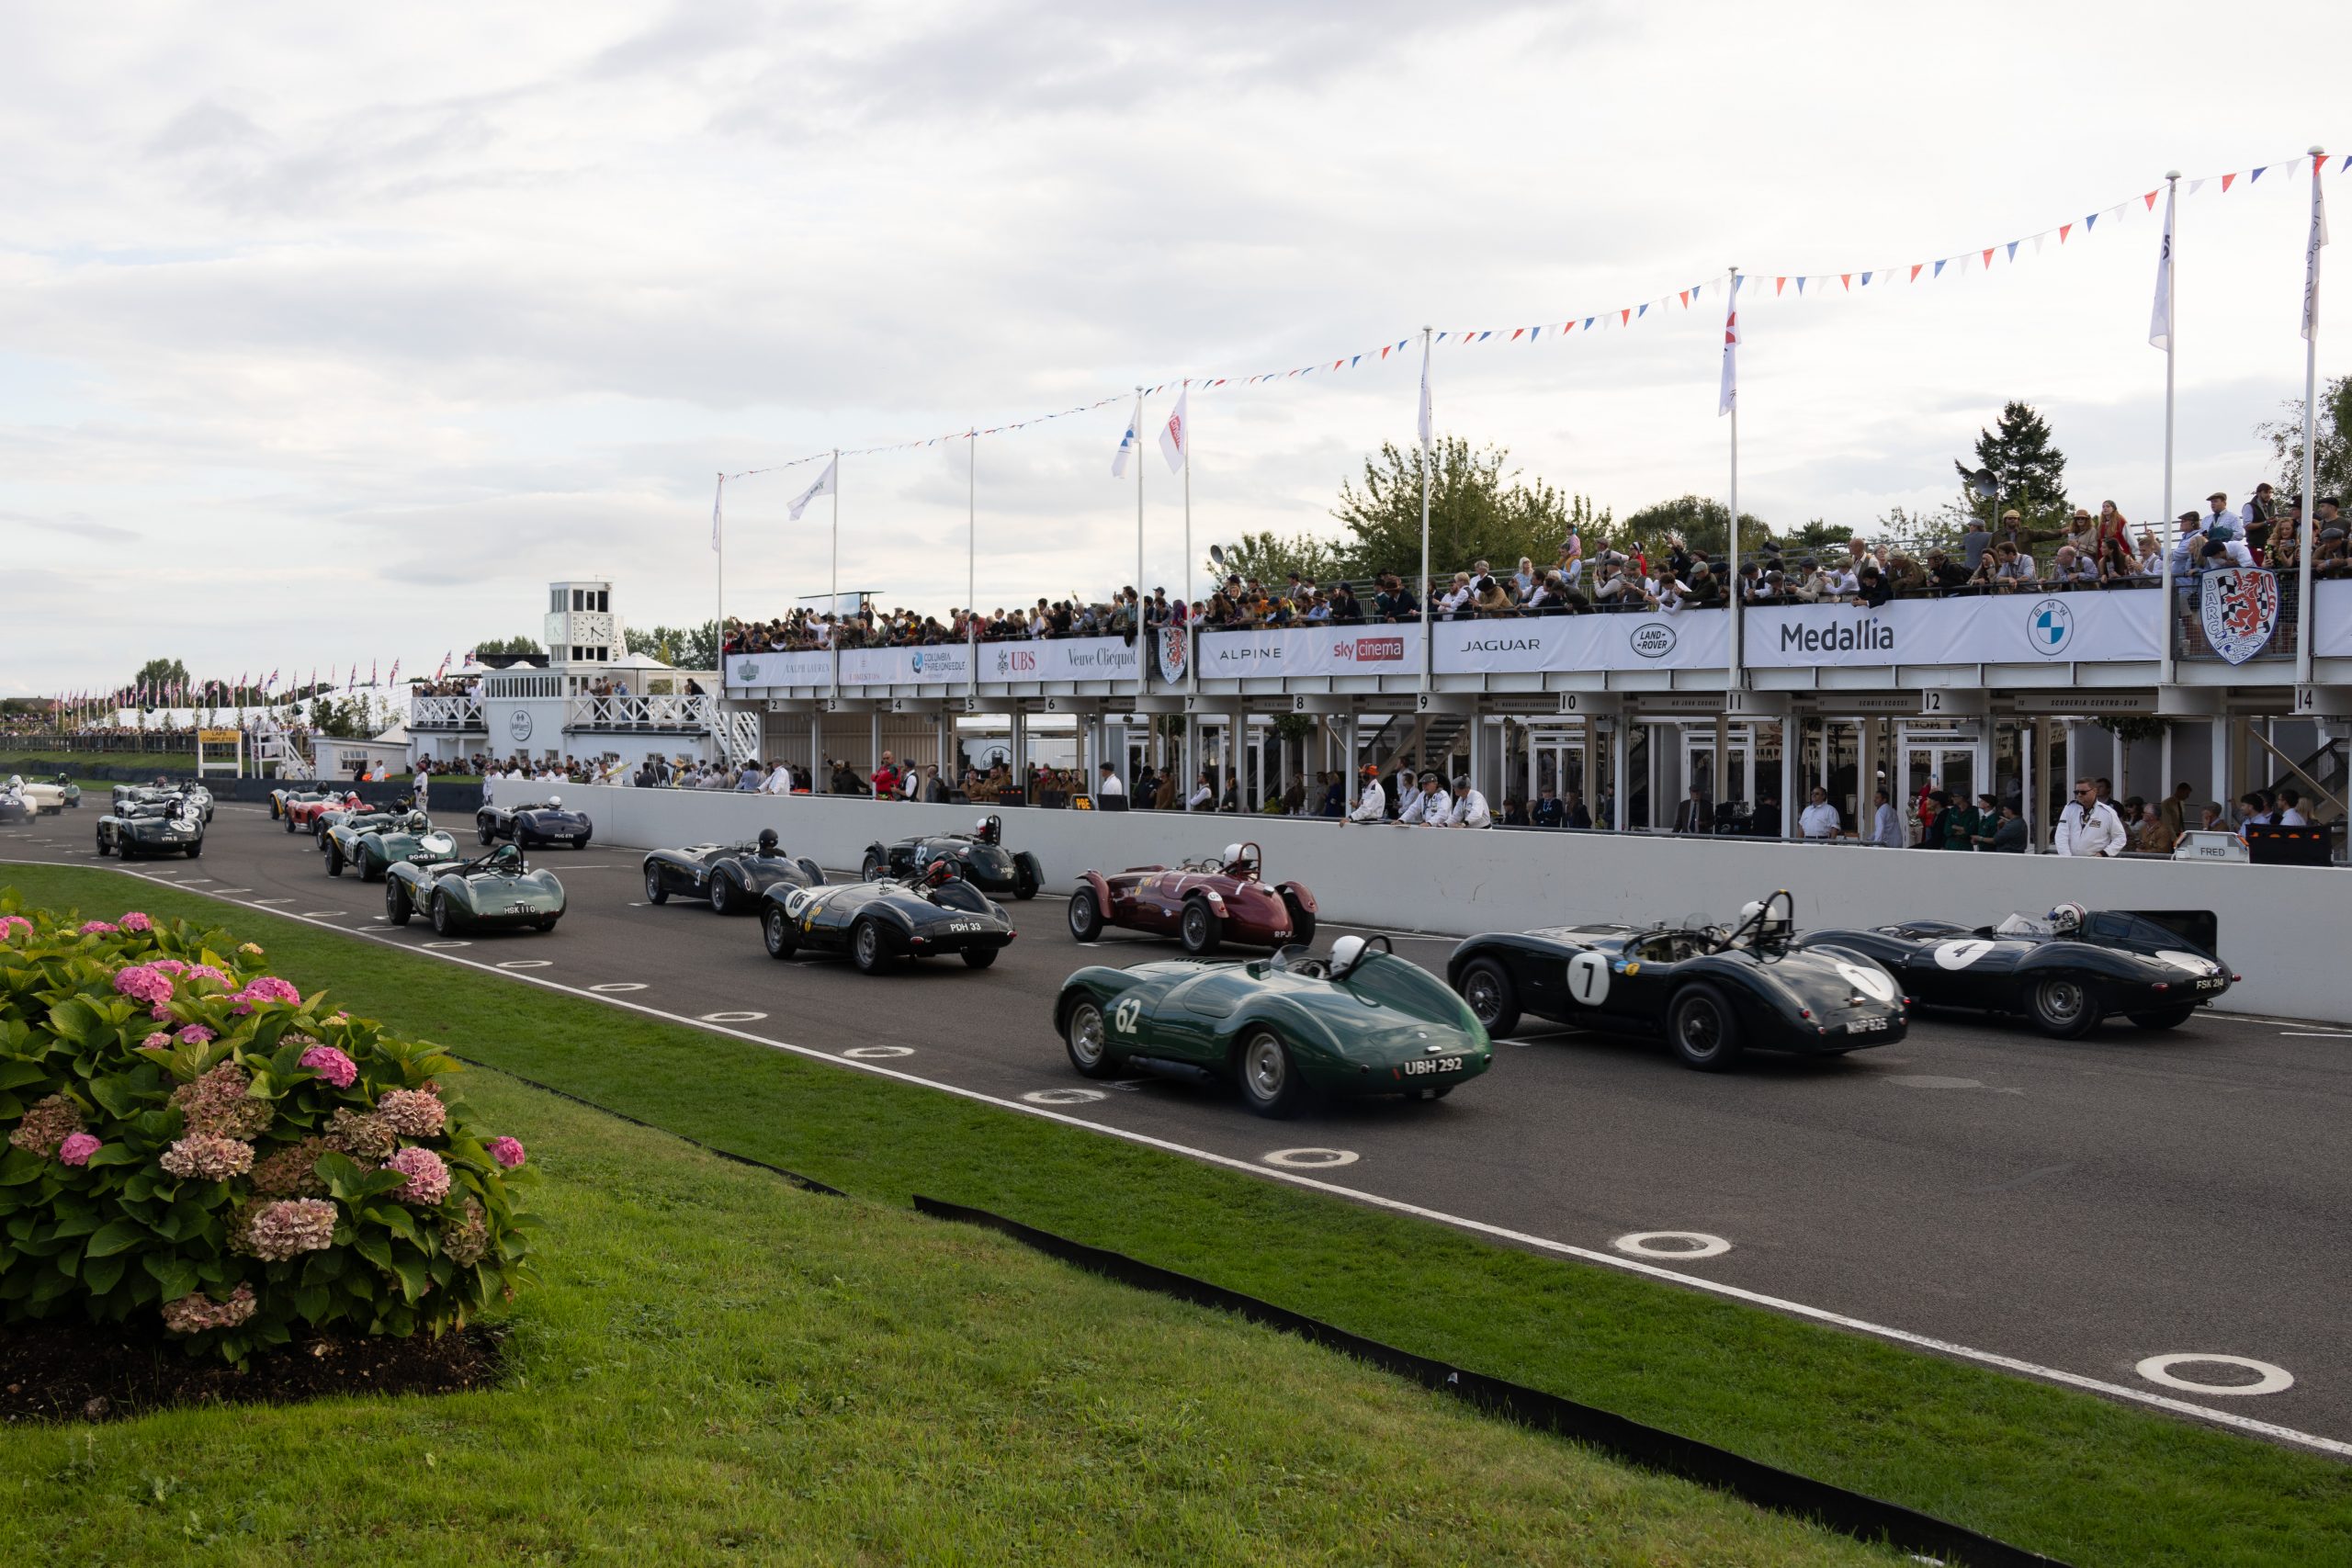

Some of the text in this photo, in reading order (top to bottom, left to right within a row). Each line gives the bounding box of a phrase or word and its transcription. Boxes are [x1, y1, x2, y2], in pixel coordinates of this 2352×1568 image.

[2033, 602, 2068, 617] BMW
[1781, 616, 1894, 652] Medallia
[1333, 640, 1401, 660] sky cinema
[1461, 638, 1541, 652] JAGUAR
[923, 652, 952, 662] COLUMBIA
[1011, 650, 1035, 671] UBS
[1068, 647, 1136, 670] Veuve Clicquot
[1219, 648, 1282, 660] ALPINE
[923, 661, 966, 671] THREADNEEDLE
[772, 700, 777, 710] 2
[830, 700, 836, 710] 3
[895, 700, 902, 710] 4
[967, 699, 975, 710] 5
[1047, 699, 1056, 710] 6
[1187, 697, 1194, 709] 7
[1296, 696, 1304, 709] 8
[1420, 695, 1428, 709] 9
[1562, 694, 1577, 710] 10
[1729, 694, 1742, 710] 11
[1926, 693, 1940, 710] 12
[2298, 690, 2312, 709] 14
[915, 846, 928, 864] 22
[2200, 847, 2225, 857] FRED
[695, 870, 701, 886] 3
[788, 891, 811, 909] 16
[950, 922, 981, 931] PDH 33
[1952, 942, 1979, 957] 4
[1581, 962, 1595, 998] 7
[1115, 998, 1141, 1034] 62
[1404, 1056, 1463, 1075] UBH 292
